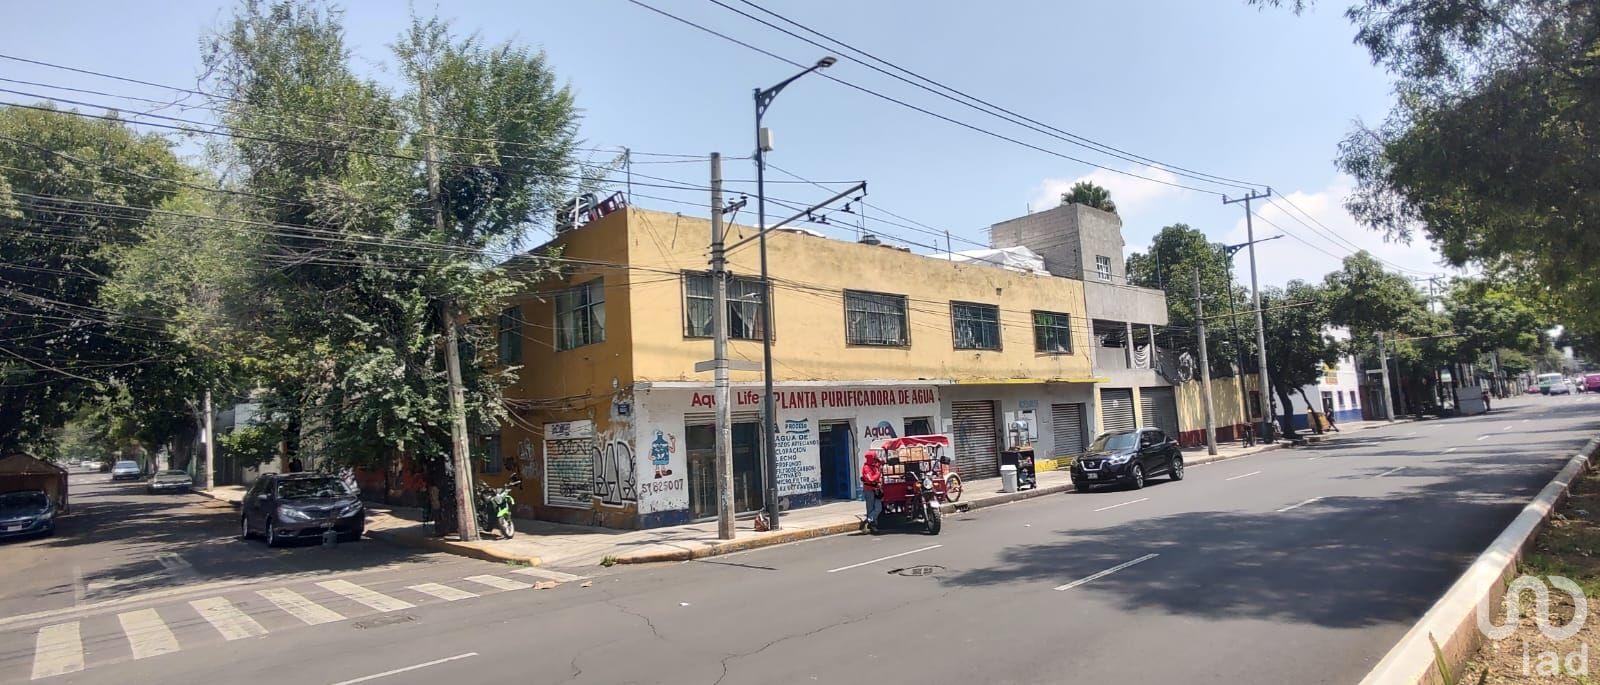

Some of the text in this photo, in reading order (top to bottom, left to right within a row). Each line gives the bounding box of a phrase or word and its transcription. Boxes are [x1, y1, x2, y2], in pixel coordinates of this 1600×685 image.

[737, 390, 760, 405] Life
[773, 389, 935, 409] PLANTA PURIFICADORA DE AGUA
[864, 425, 892, 438] Aqua
